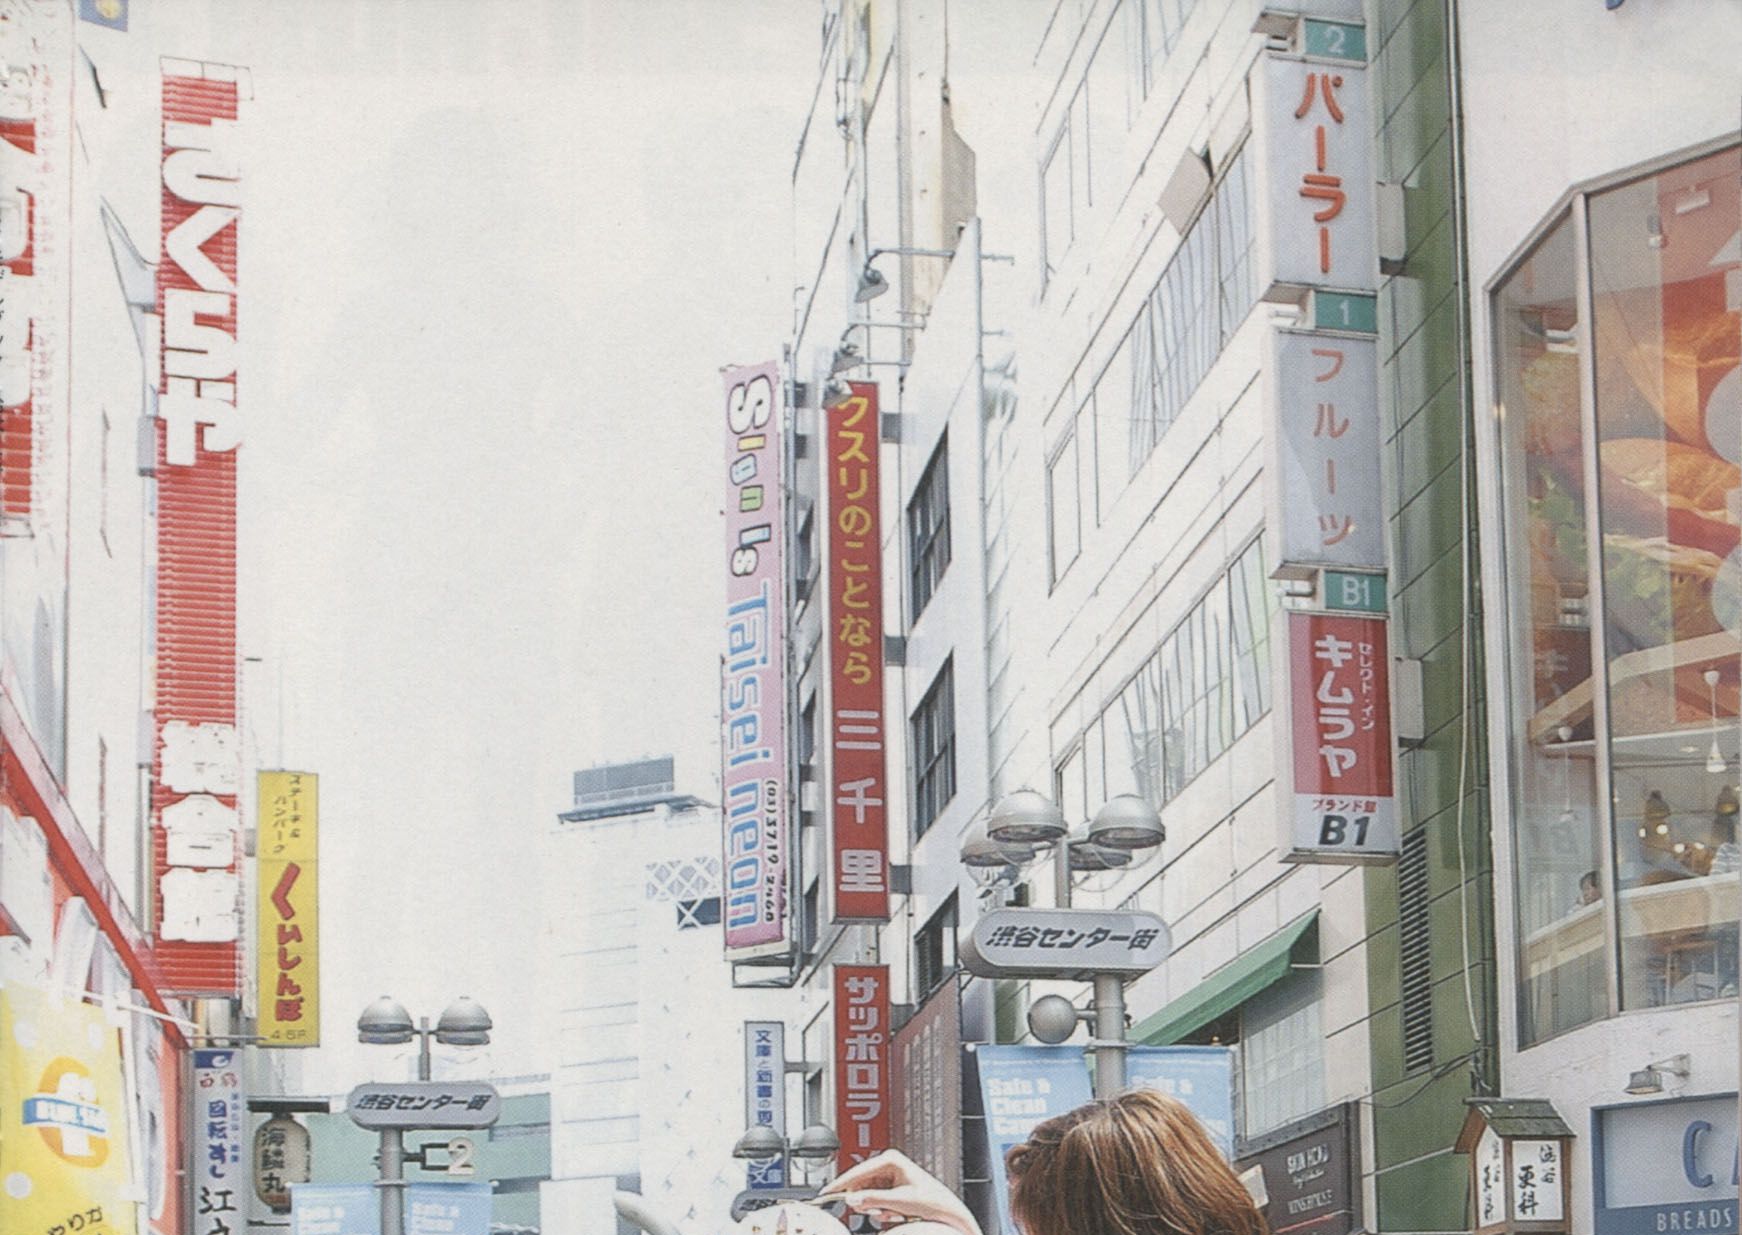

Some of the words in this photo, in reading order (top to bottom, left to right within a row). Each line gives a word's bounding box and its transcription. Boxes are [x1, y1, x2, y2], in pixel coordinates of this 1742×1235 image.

[1325, 26, 1346, 53] 2
[1294, 72, 1346, 273] パーラー
[1339, 302, 1349, 325] 1
[1312, 349, 1352, 546] フルーツ
[837, 396, 872, 685] クスリのことなら
[1343, 577, 1370, 606] B1
[728, 581, 770, 766] Taisei
[1315, 634, 1357, 778] キムラヤ
[730, 782, 760, 928] neon
[836, 709, 884, 893] 三千里
[1318, 814, 1370, 847] B1
[271, 862, 303, 1021] くいしん坊
[985, 925, 1160, 950] 渋谷センター街
[448, 1137, 474, 1175] 2
[1657, 1207, 1733, 1232] BREADS
